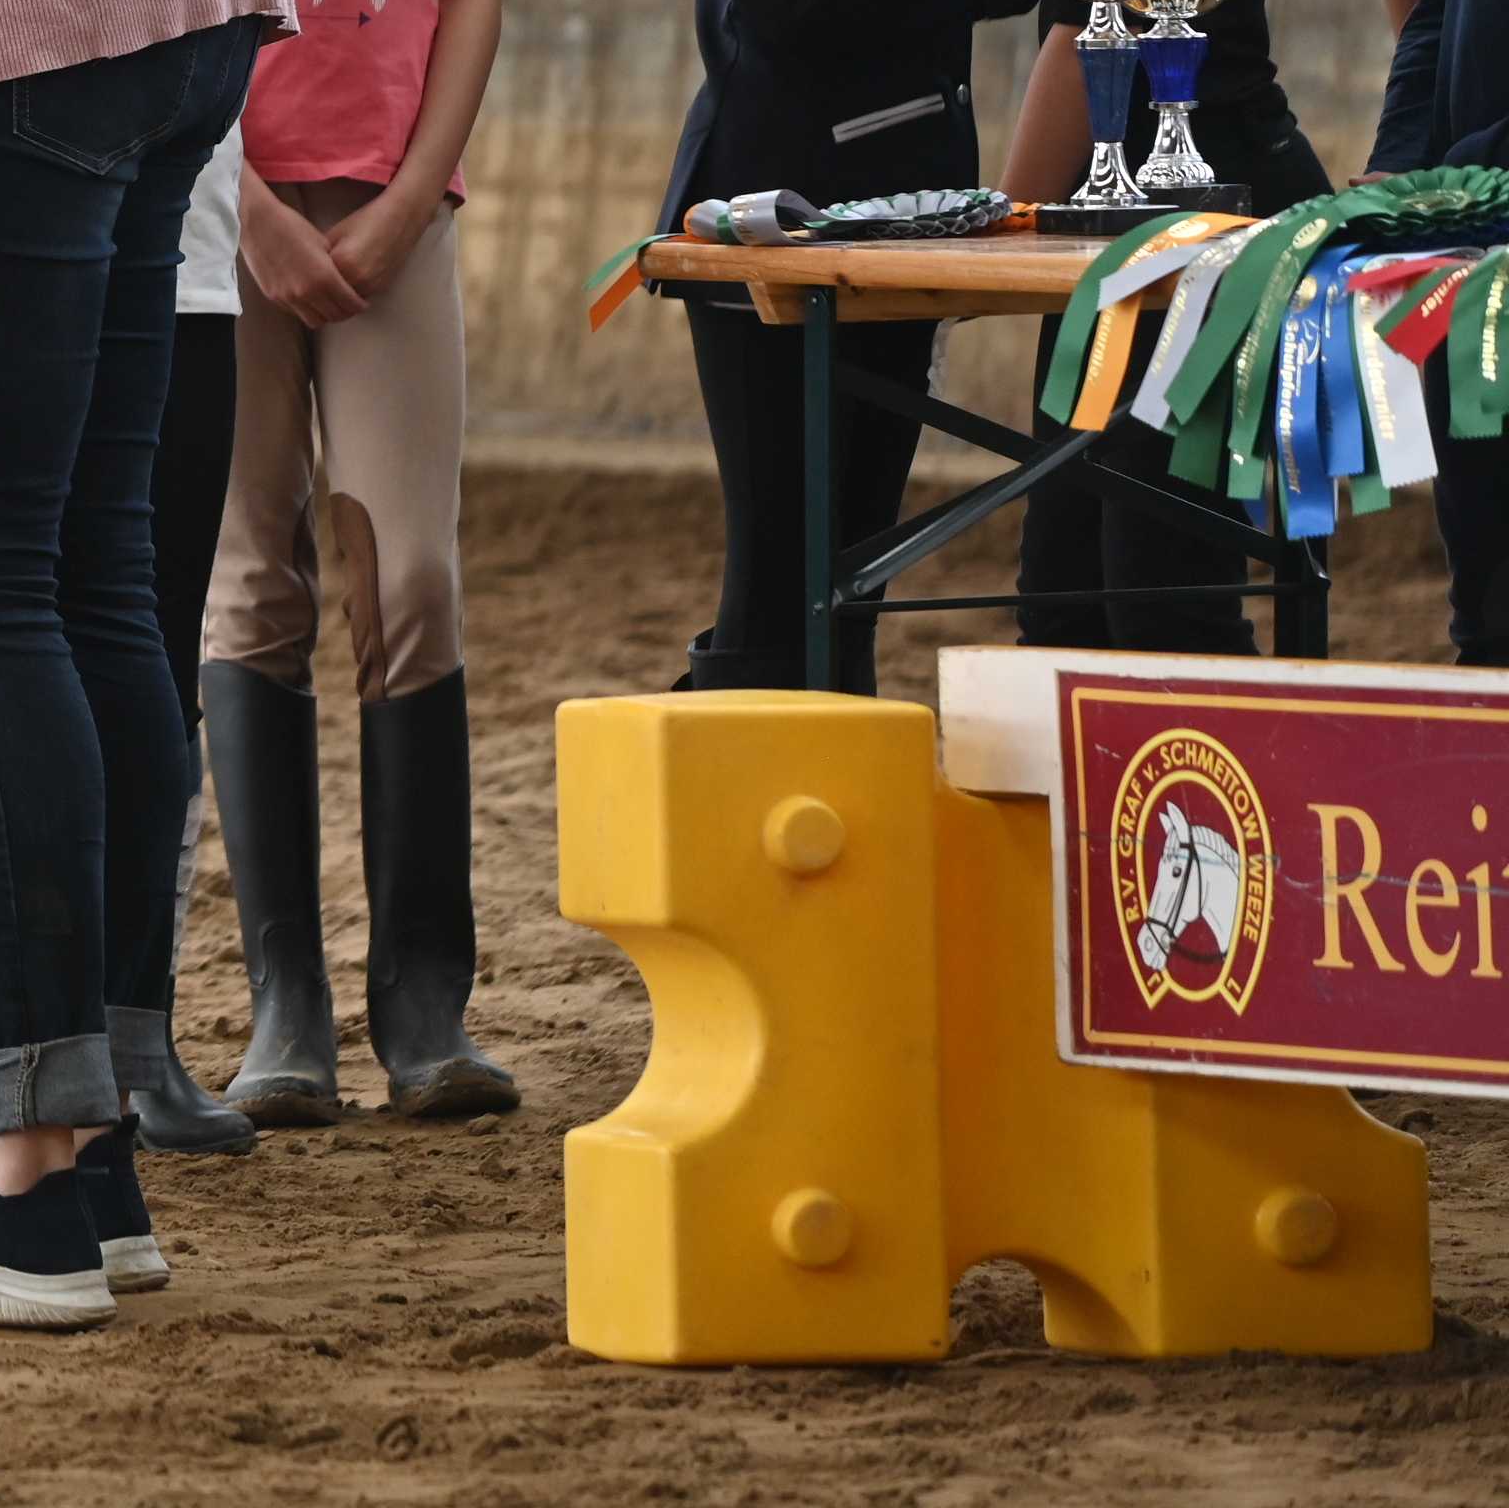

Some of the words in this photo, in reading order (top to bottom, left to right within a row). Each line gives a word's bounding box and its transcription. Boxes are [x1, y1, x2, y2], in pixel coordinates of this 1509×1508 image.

[1118, 779, 1144, 858] GRAF
[1160, 741, 1261, 839] SCHMETTOW
[1243, 853, 1265, 943] WEEZE
[1307, 802, 1509, 979] Rei
